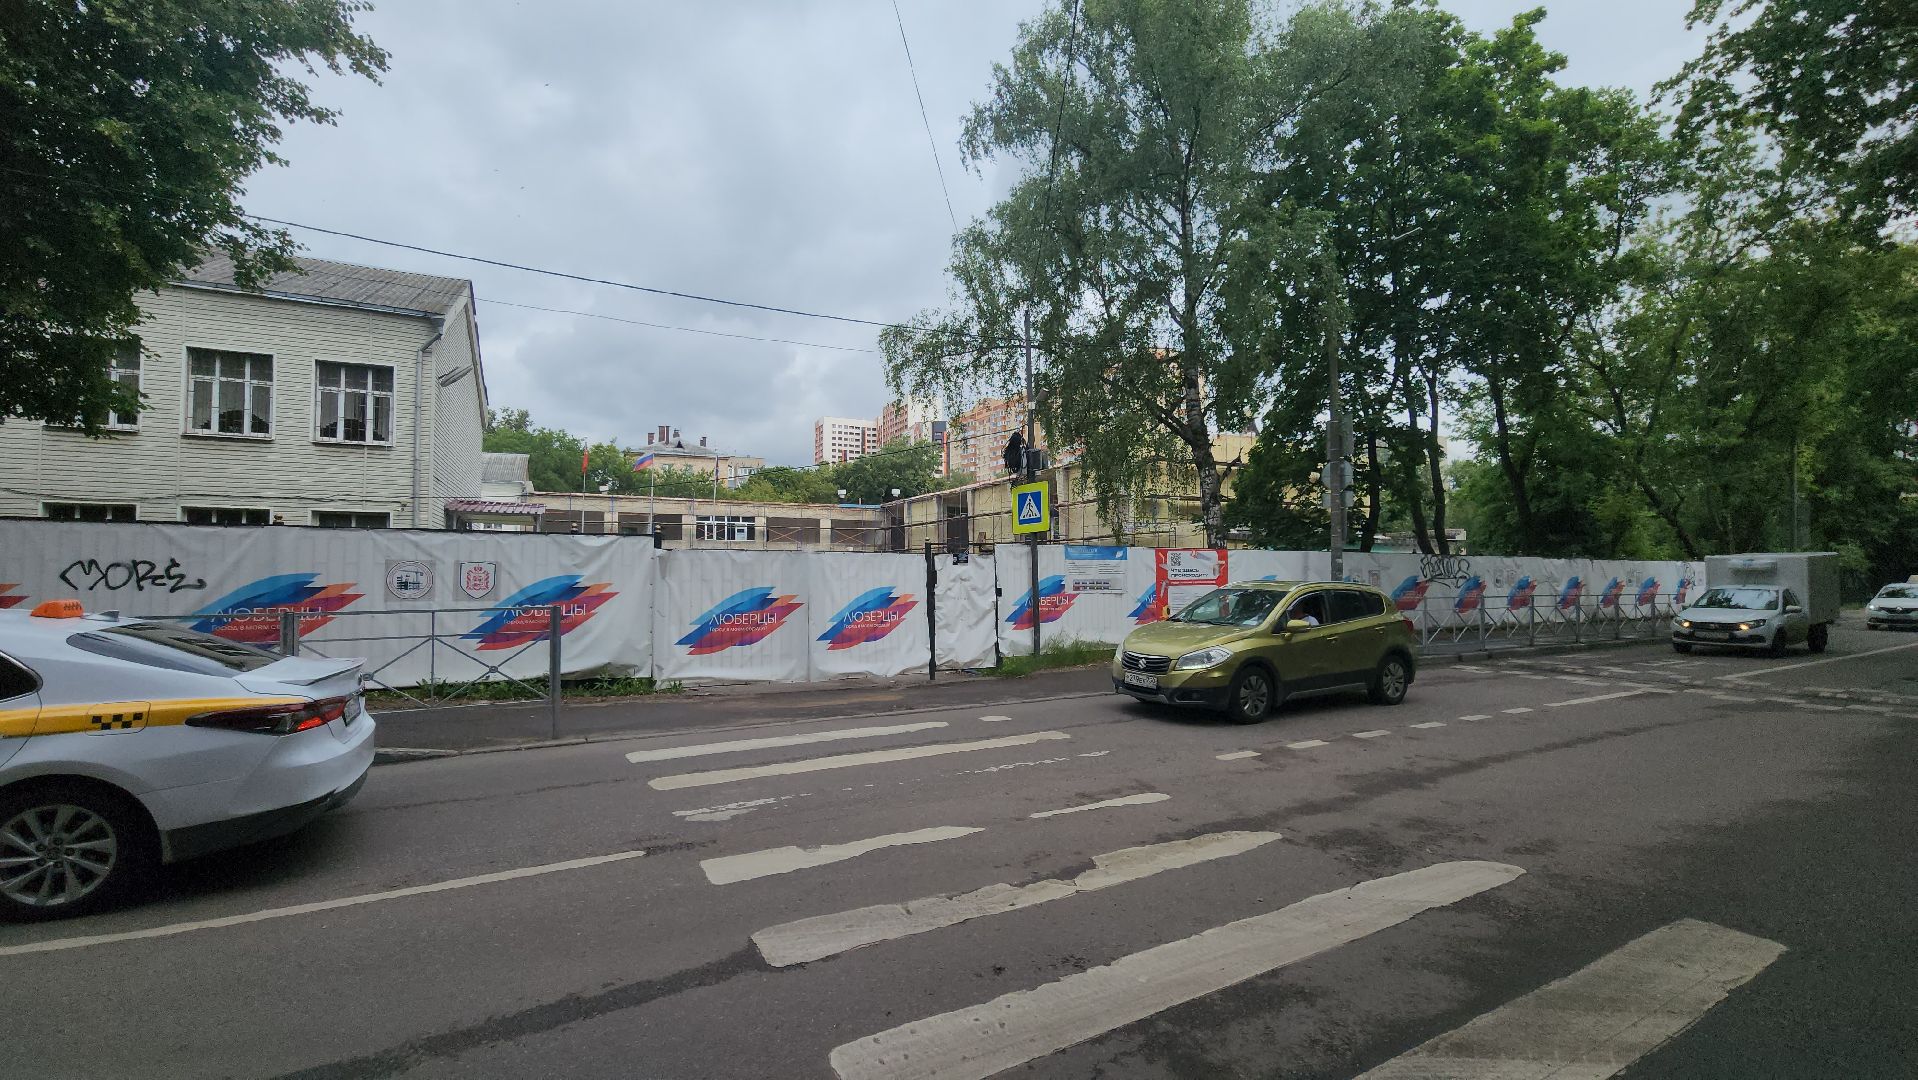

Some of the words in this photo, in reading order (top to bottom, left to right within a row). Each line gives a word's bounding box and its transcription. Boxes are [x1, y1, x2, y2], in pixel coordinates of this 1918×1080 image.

[1025, 596, 1069, 606] ЛБЕРЦЫ
[709, 613, 777, 625] ЛЮБЕРЦЫ
[844, 610, 899, 623] ЛЮБЕРЦЫ
